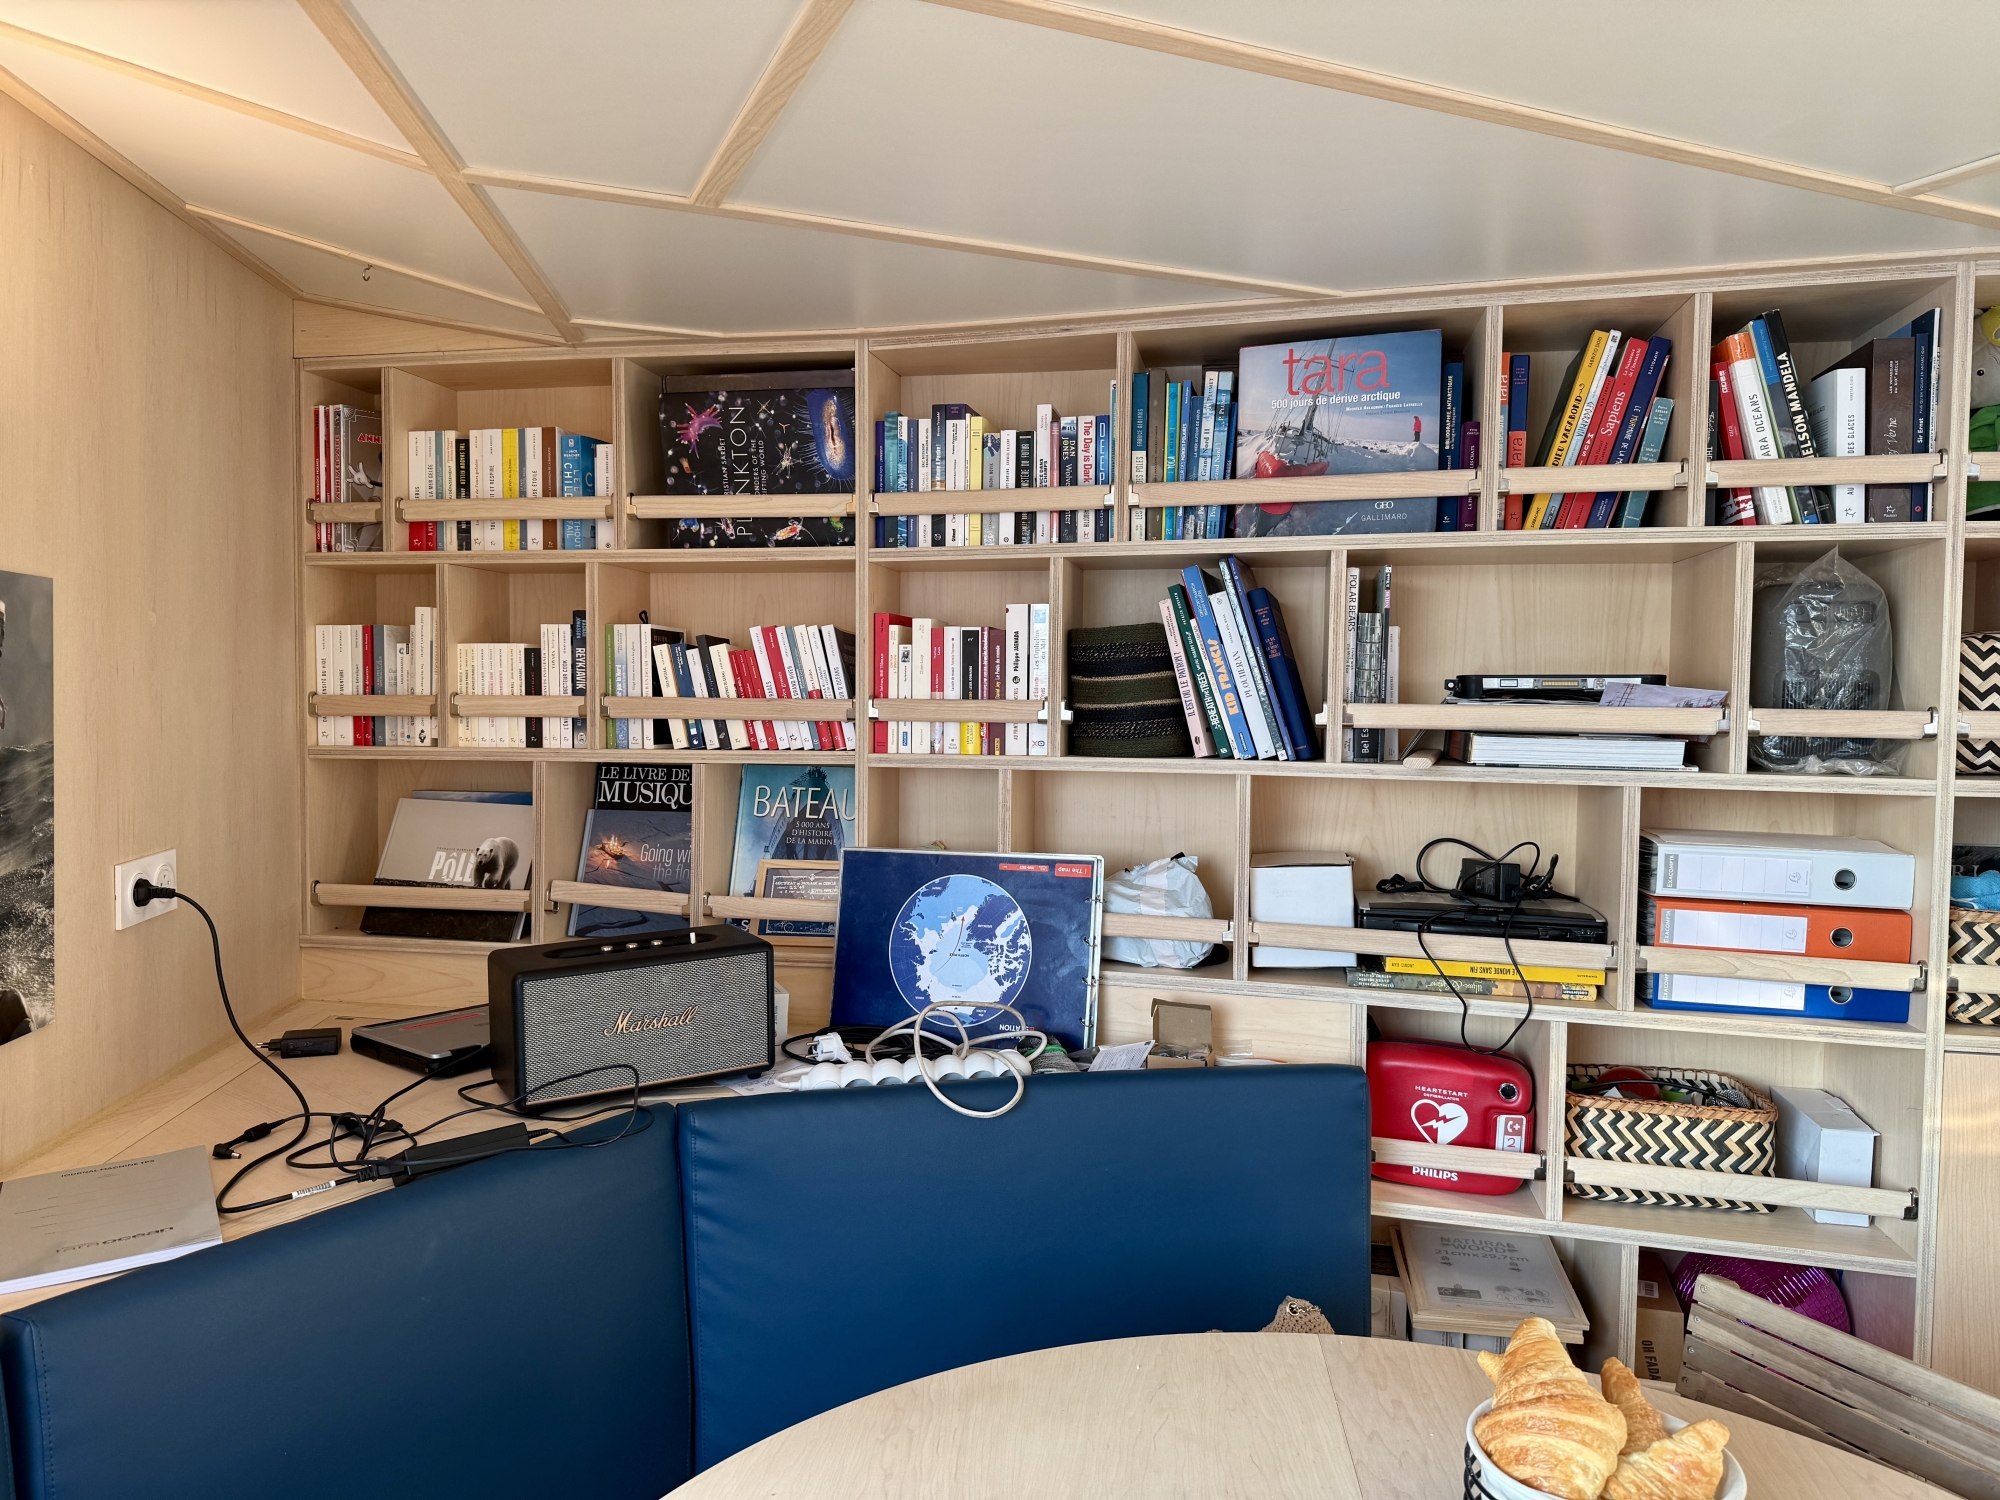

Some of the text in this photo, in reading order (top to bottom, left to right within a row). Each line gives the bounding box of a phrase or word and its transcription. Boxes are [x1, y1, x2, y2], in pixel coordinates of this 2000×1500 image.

[1588, 348, 1600, 367] FABRIZIO
[1282, 348, 1390, 396] tara
[1777, 351, 1800, 411] MANDELA
[1271, 390, 1401, 410] 500 jours de dérive arctique
[1559, 395, 1583, 443] VAGABOND
[1600, 391, 1626, 436] Sapiens
[1749, 394, 1765, 433] OCEANS
[1582, 432, 1594, 456] MAUS
[1847, 414, 1855, 454] DES GLACES
[758, 440, 766, 466] WORLD
[1020, 443, 1029, 458] FUTUR
[1062, 437, 1070, 460] JONES
[1082, 420, 1093, 483] The Day is Dark
[1099, 423, 1107, 485] DEEP
[1511, 437, 1523, 467] tara
[752, 455, 759, 465] OF
[530, 470, 538, 487] ÉTOILE
[573, 469, 581, 492] LEE
[728, 408, 753, 536] PLNKTON
[1064, 463, 1073, 486] Wolve
[1847, 488, 1854, 496] AU
[1361, 513, 1407, 522] GALLIMARD
[565, 520, 573, 538] FAIL
[573, 520, 581, 549] THOUT
[1347, 574, 1357, 632] POLAR BEARS
[575, 648, 586, 690] REYKJAVIK
[1174, 656, 1188, 679] PATRON
[1206, 638, 1233, 690] FRANCIS
[1179, 679, 1190, 688] LE
[1196, 672, 1210, 692] TREES
[1184, 699, 1195, 711] EST
[1203, 696, 1221, 726] BENEATH
[1223, 691, 1240, 716] KID
[1361, 740, 1370, 754] Bel
[601, 766, 690, 781] LE LIVRE DE
[791, 829, 833, 838] D'HISTOIRE
[795, 820, 830, 830] 5 000 ANS
[808, 838, 837, 846] MARINE
[641, 843, 675, 867] Going
[653, 864, 672, 881] the
[1058, 866, 1071, 874] map
[1663, 910, 1671, 944] EXACOMPTA
[1470, 965, 1479, 973] FIN
[1479, 966, 1494, 974] SANS
[1494, 966, 1511, 975] MONDE
[604, 1005, 699, 1037] Marshall
[1414, 1085, 1469, 1098] HEARTSTART
[1423, 1092, 1460, 1102] DEFIBRILLATOR
[1507, 1137, 1516, 1148] 2
[61, 1168, 99, 1178] JOURNAL
[100, 1162, 138, 1172] MACHINE
[1412, 1165, 1459, 1181] PHILIPS
[1451, 1243, 1509, 1254] WOOD
[1642, 1339, 1655, 1354] OH
